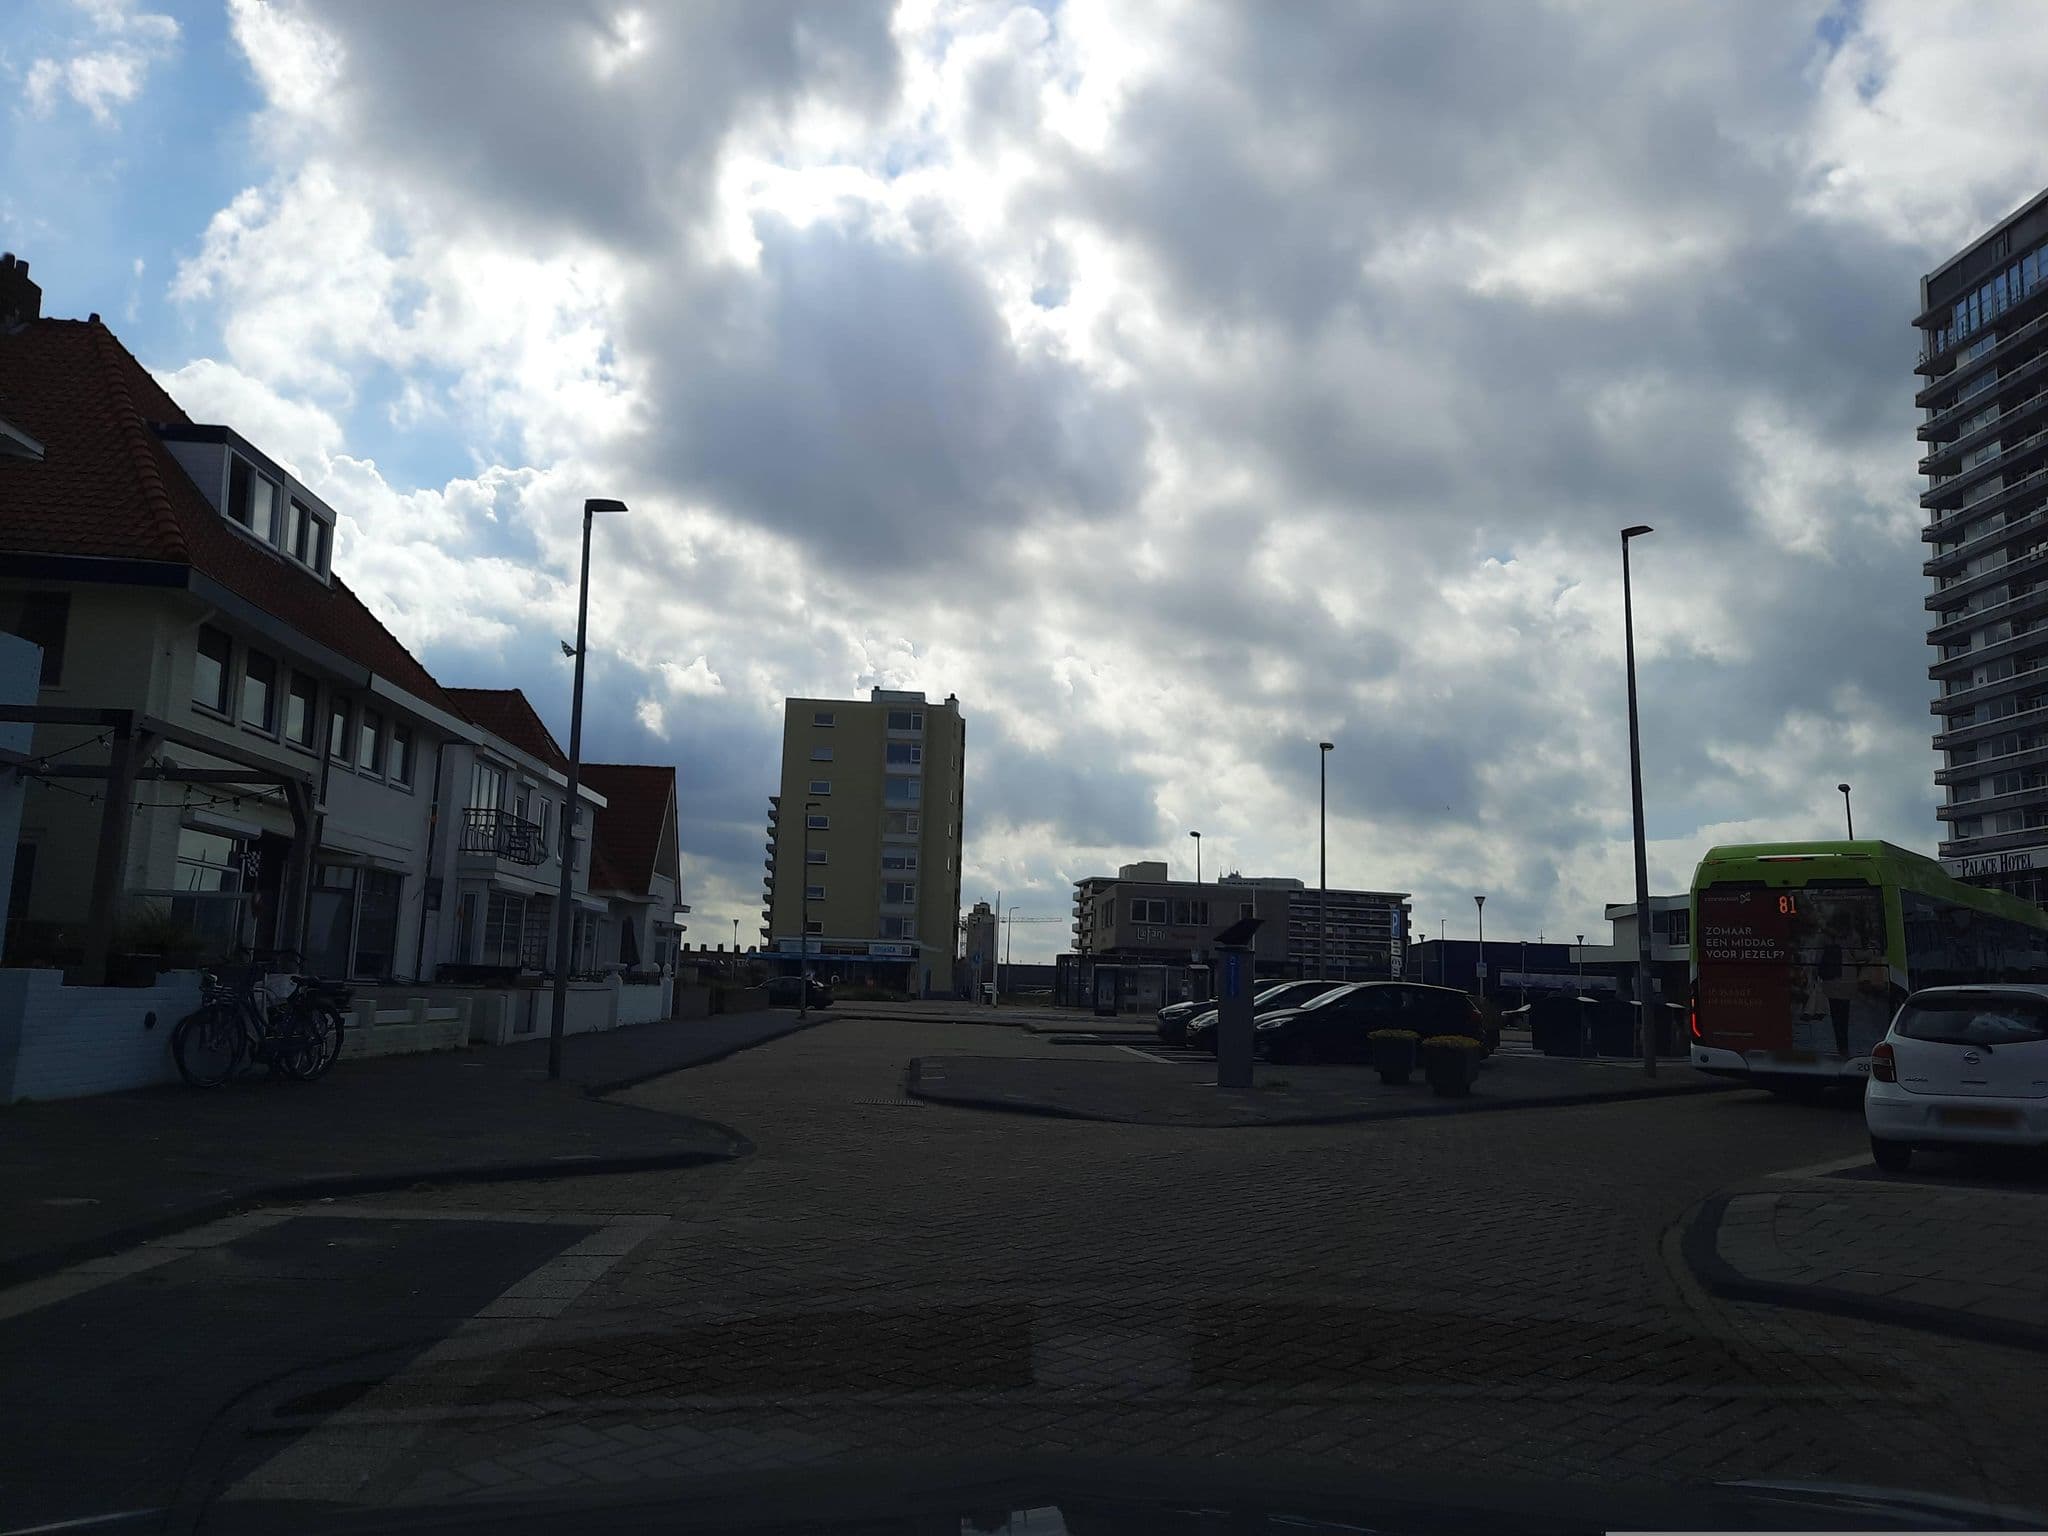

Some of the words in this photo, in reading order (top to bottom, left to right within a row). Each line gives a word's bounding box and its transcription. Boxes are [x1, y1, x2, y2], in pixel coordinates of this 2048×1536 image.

[1962, 857, 1997, 877] PALACE
[2000, 852, 2033, 872] HOTEL
[1779, 895, 1797, 914] 81
[1705, 926, 1752, 936] ZOMAAR
[1705, 938, 1728, 948] EEN
[1731, 938, 1776, 948] MIDDAG
[1705, 949, 1737, 959] VOOR
[1740, 949, 1785, 960] JEZELF?
